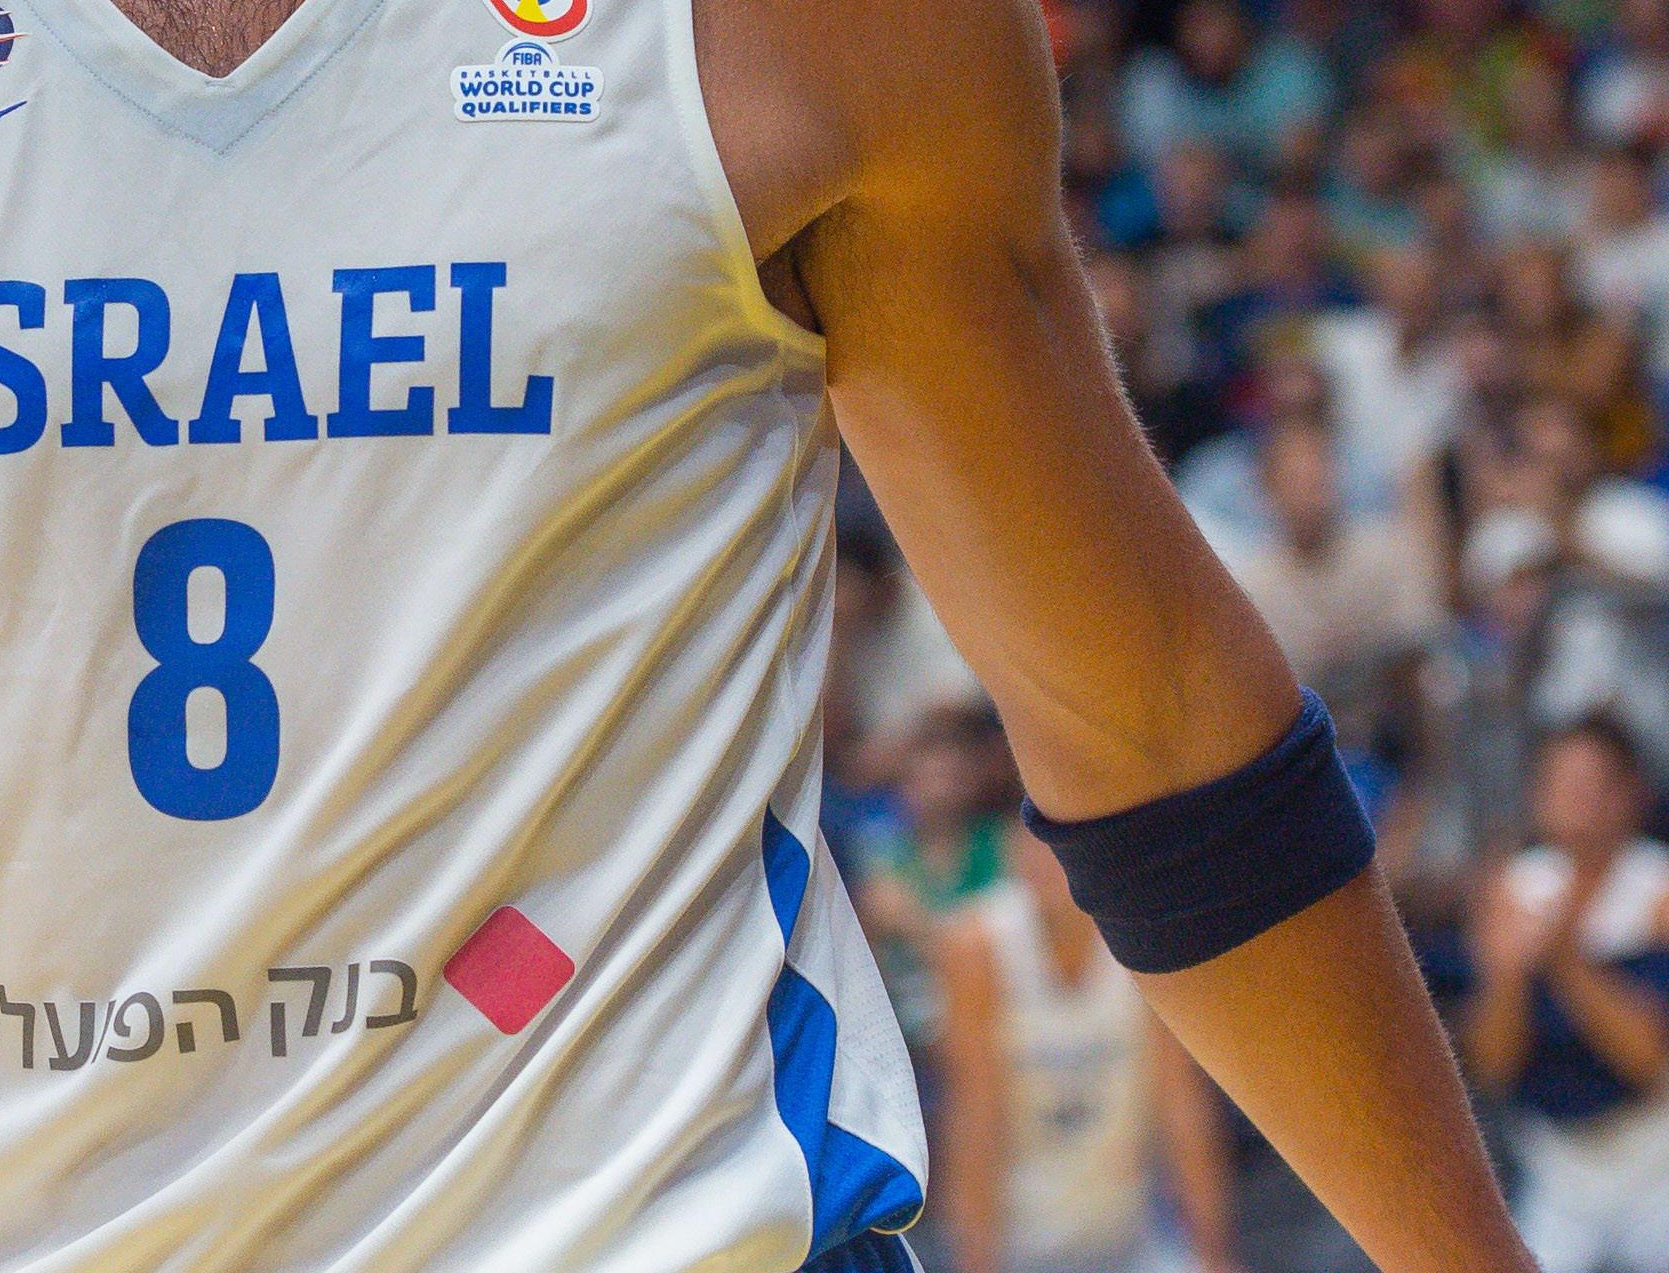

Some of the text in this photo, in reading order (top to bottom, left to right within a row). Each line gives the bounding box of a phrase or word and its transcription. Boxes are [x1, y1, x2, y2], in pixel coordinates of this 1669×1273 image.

[512, 52, 542, 66] FIBA
[461, 69, 591, 79] BASKETBALL
[460, 80, 595, 98] WORLD CUP
[461, 100, 592, 118] QUALIFIERS
[128, 518, 280, 821] 8
[268, 959, 418, 1057] בנק
